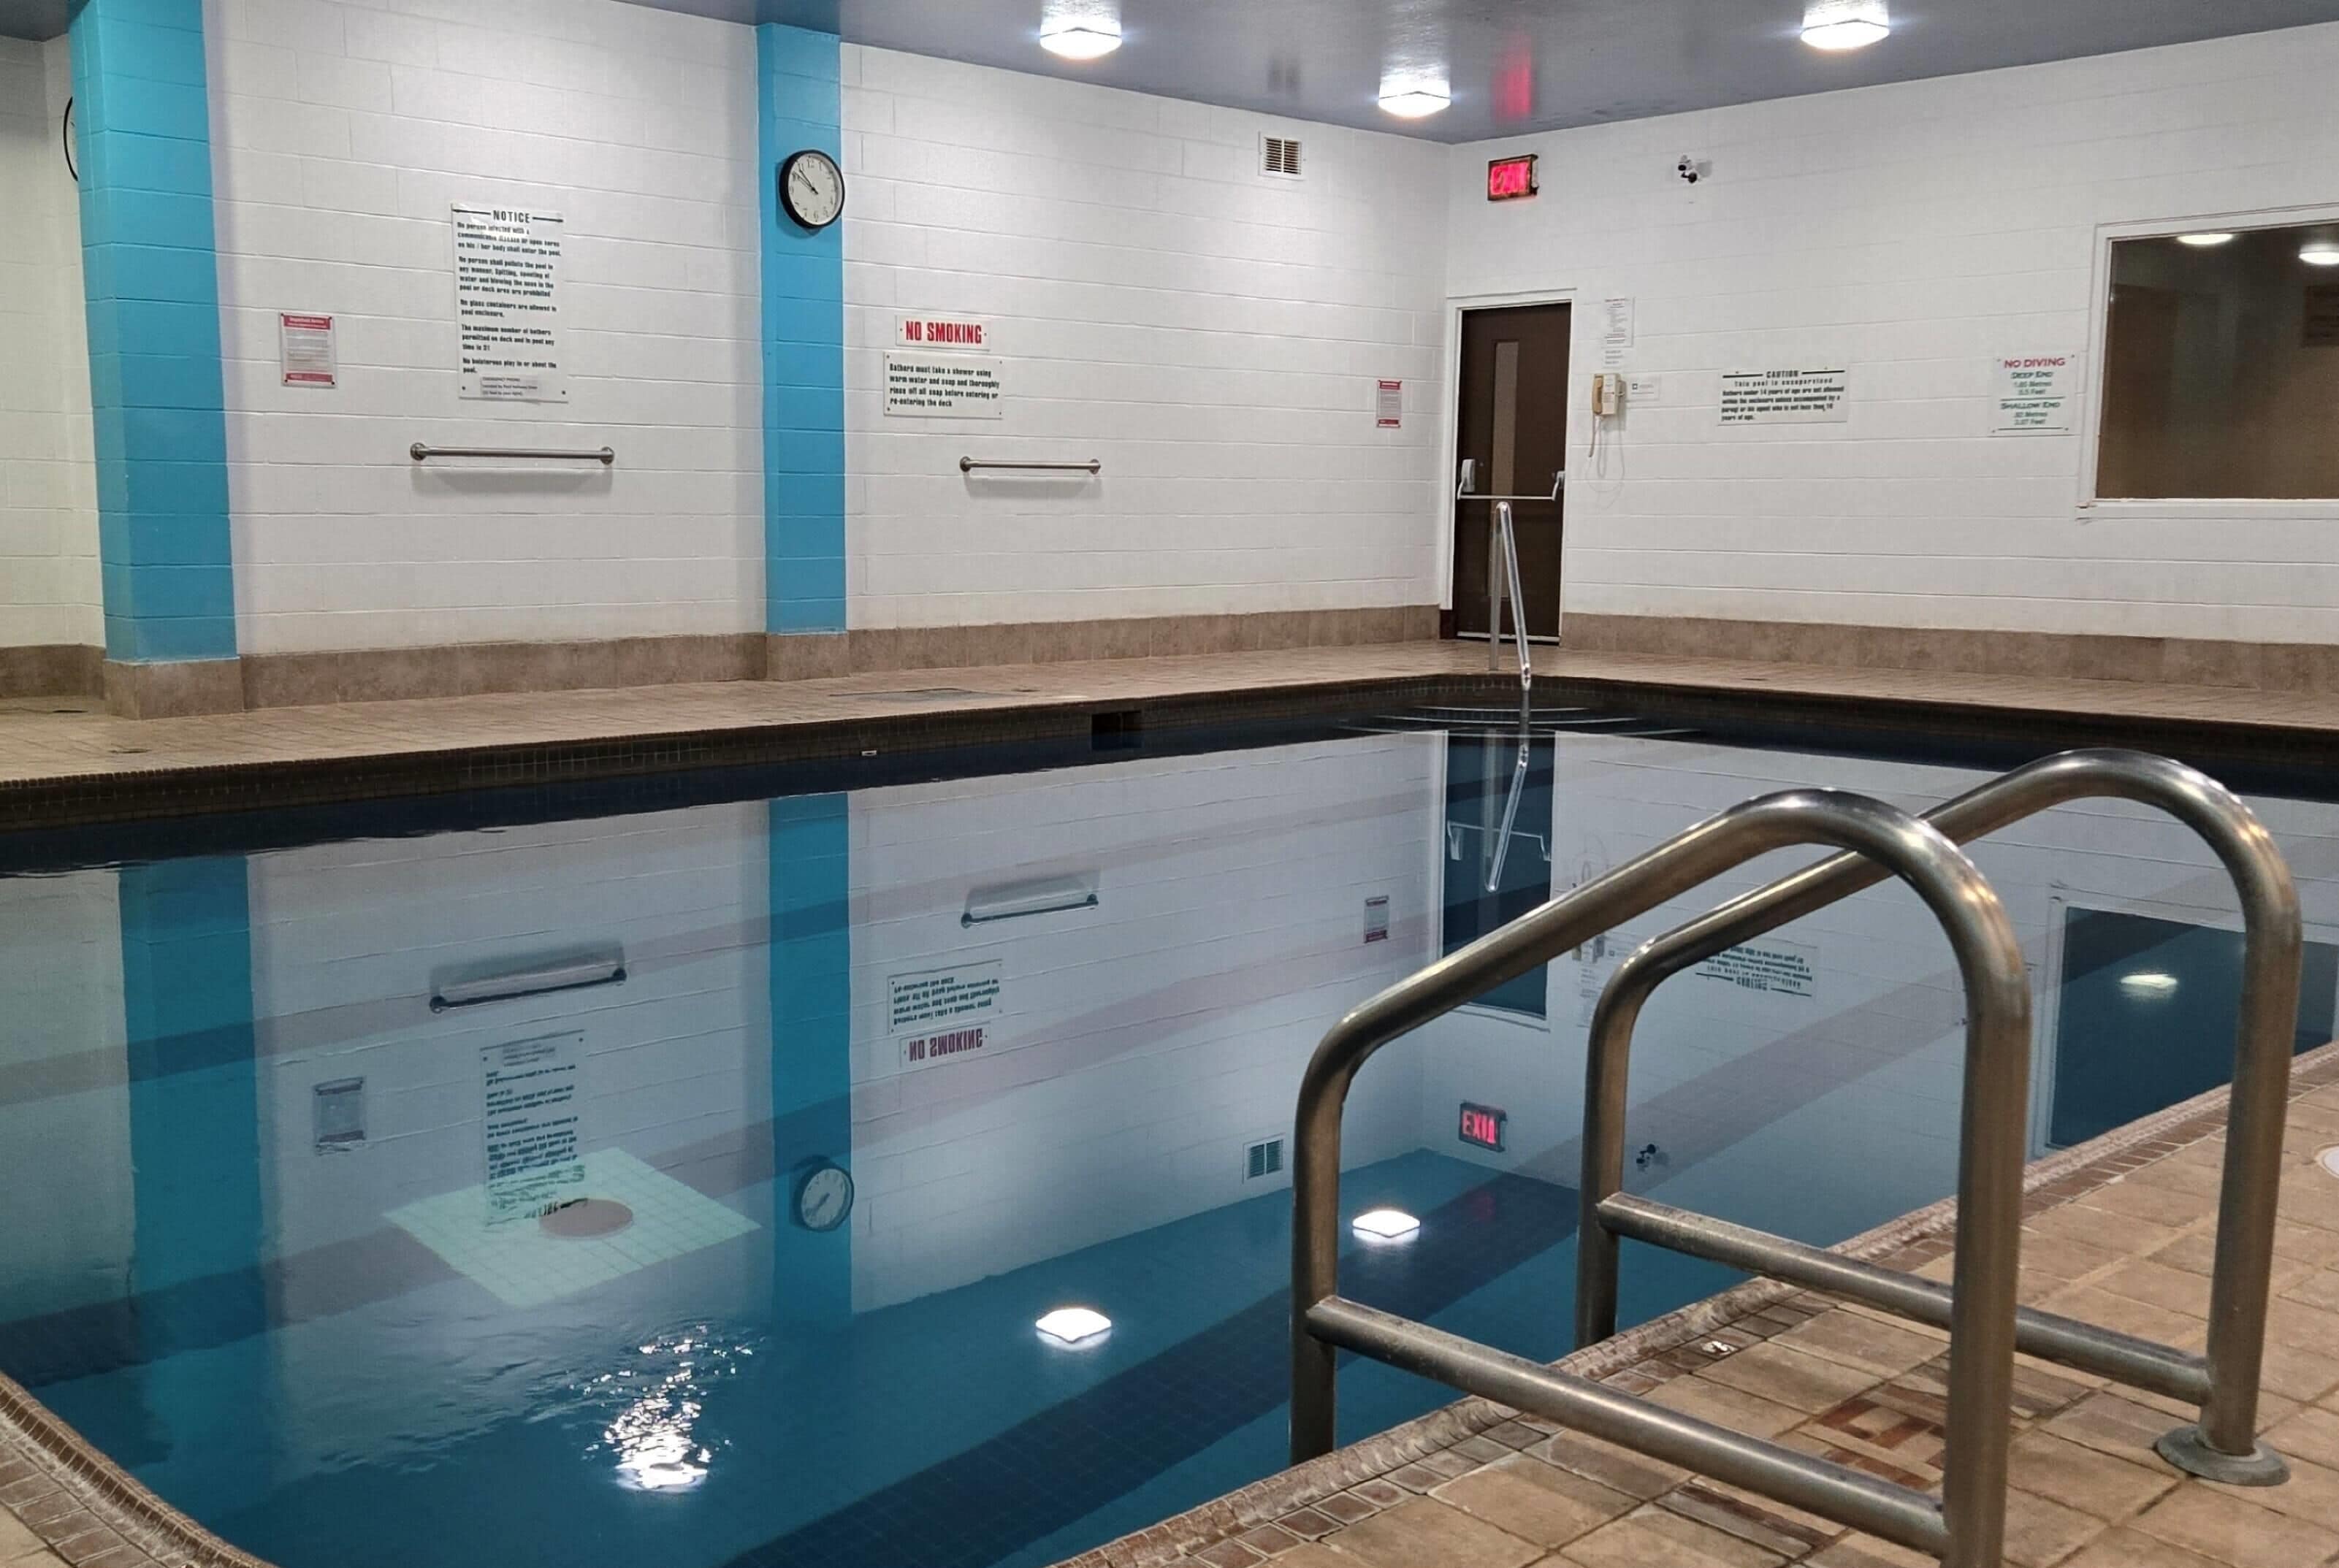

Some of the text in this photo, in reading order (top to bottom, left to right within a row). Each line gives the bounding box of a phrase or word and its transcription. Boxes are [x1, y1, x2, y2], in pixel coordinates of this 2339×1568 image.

[1492, 163, 1528, 194] EXIT
[493, 210, 530, 223] NOTICE
[488, 224, 511, 232] infected
[490, 278, 511, 286] blowing
[906, 321, 982, 344] NO SMOKING
[2004, 358, 2066, 368] NO DIVING
[889, 364, 913, 372] Bathers
[1766, 370, 1798, 378] CAUTION
[969, 380, 999, 389] thoroughly
